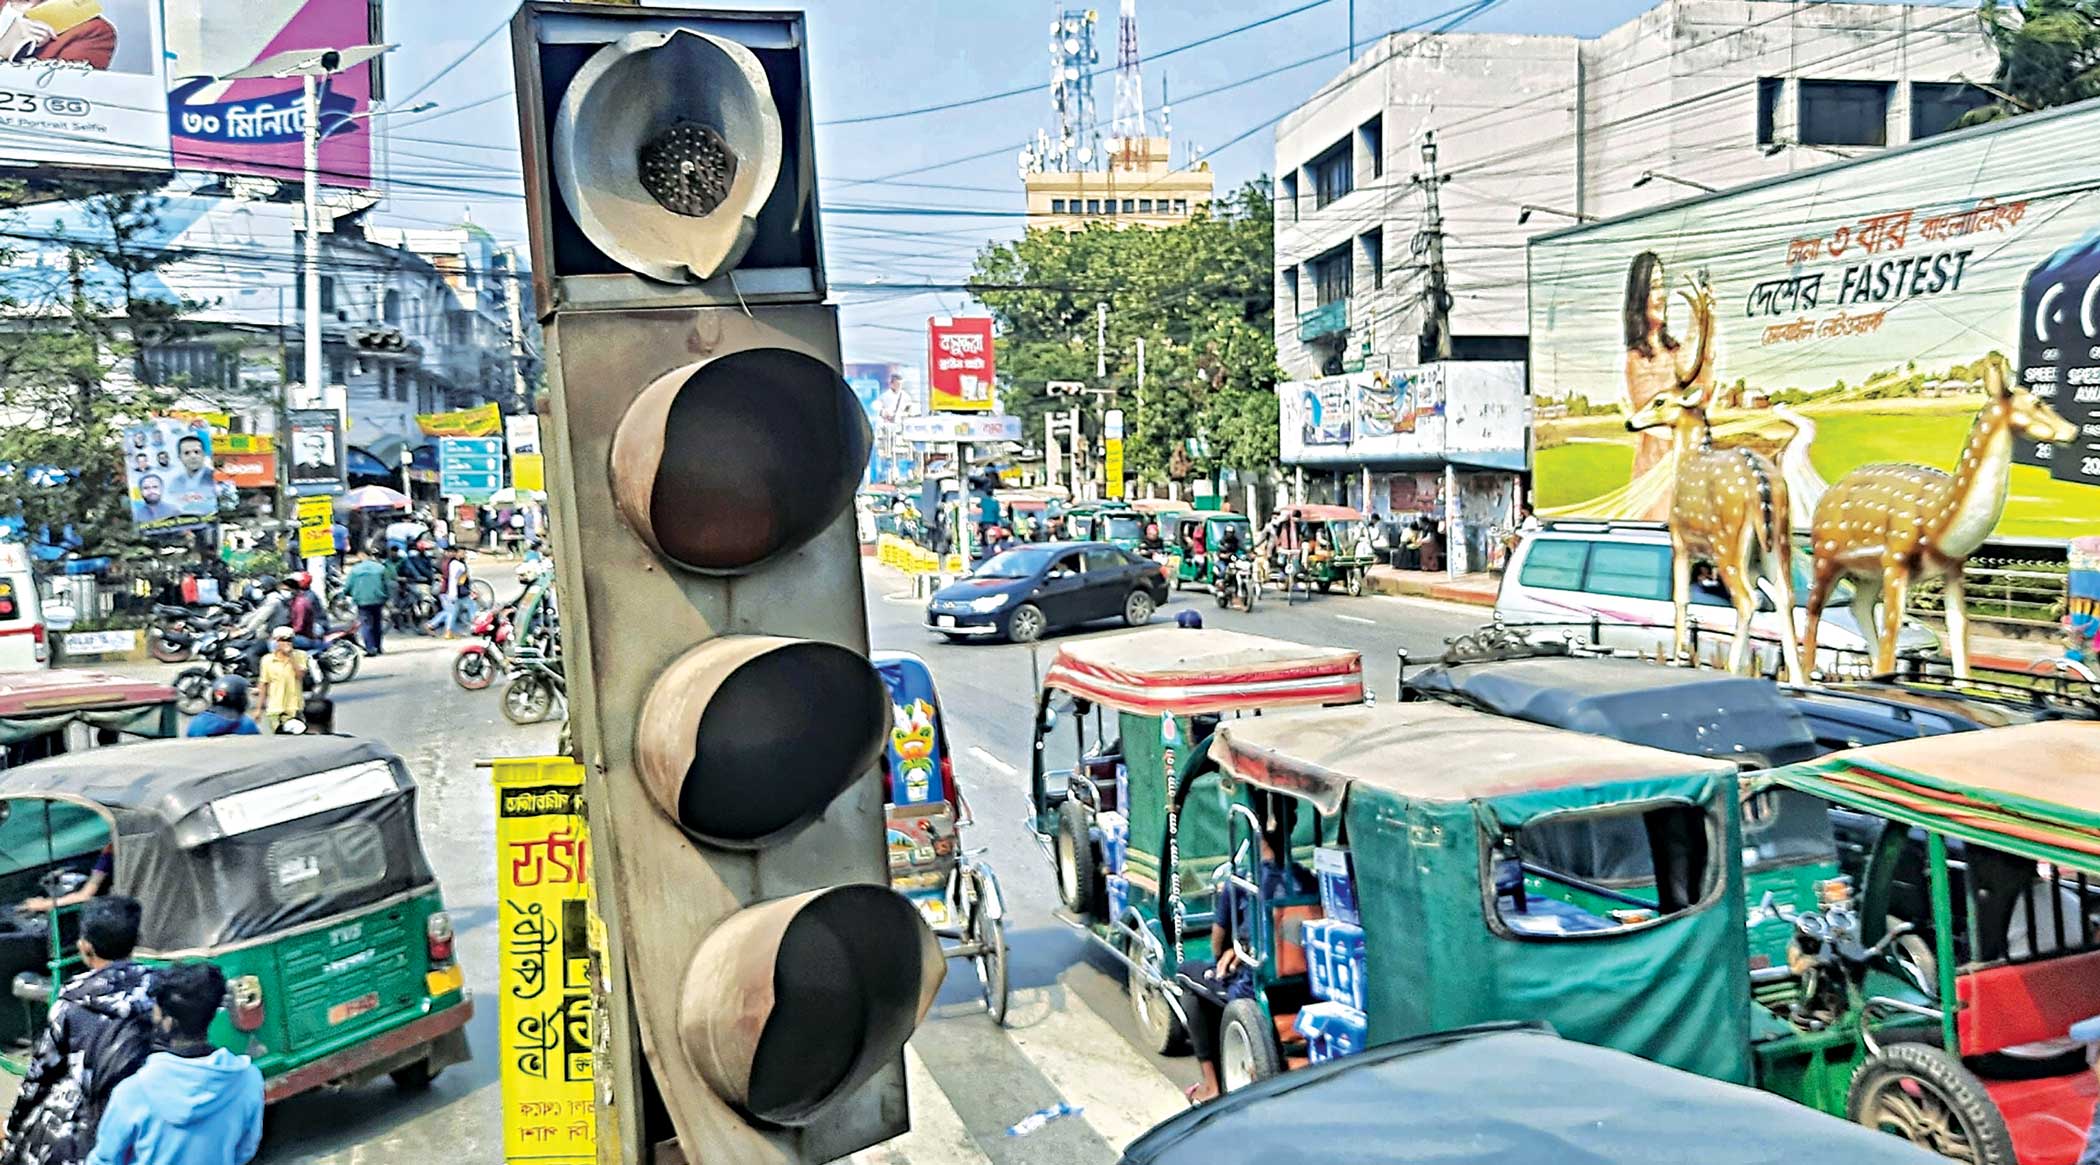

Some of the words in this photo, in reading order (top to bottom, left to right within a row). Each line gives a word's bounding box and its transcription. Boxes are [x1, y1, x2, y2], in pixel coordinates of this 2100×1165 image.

[50, 100, 83, 113] 5G
[18, 117, 68, 131] Portrait
[71, 122, 108, 133] Selfie
[182, 111, 221, 134] ৩০
[1827, 226, 1850, 257] ৩
[1856, 209, 1914, 254] বার
[1919, 198, 2029, 242] বাংলালিংক
[1746, 273, 1825, 317] দেশের
[1837, 249, 1974, 305] FASTEST
